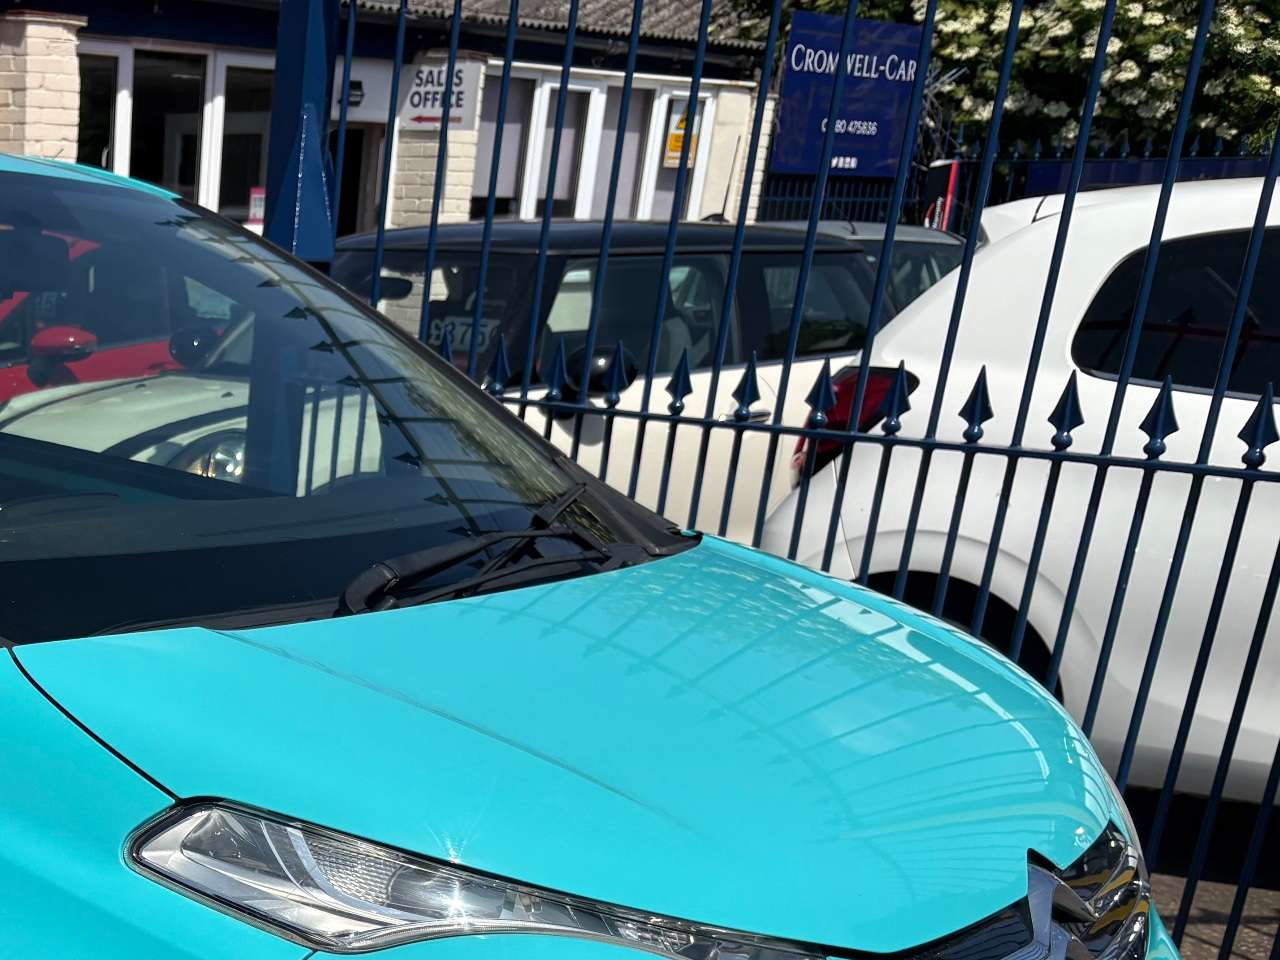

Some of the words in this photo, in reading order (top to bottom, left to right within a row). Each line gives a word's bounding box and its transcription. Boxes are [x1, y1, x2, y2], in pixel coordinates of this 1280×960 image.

[791, 43, 917, 82] CROMWELL-CAR
[415, 69, 464, 87] SALS
[821, 118, 847, 134] 080
